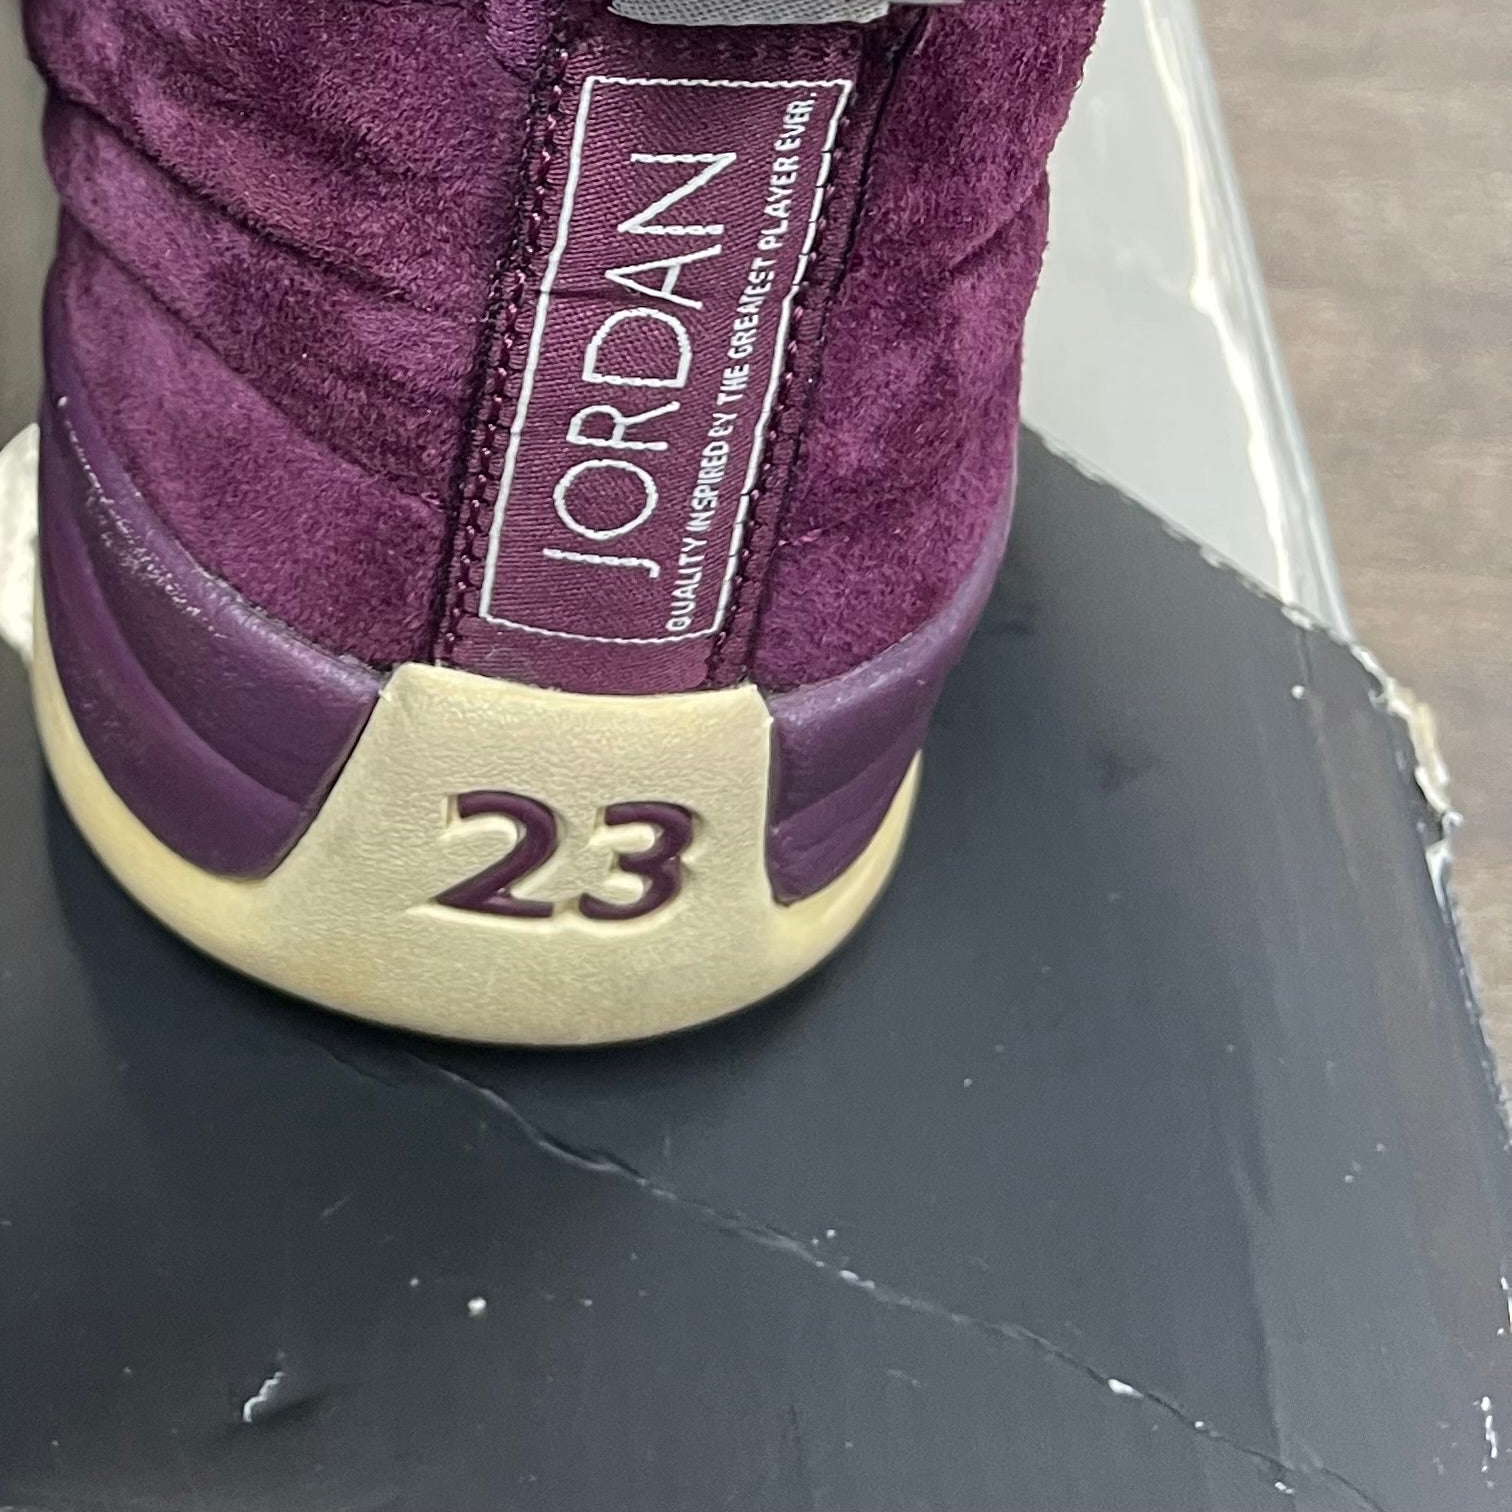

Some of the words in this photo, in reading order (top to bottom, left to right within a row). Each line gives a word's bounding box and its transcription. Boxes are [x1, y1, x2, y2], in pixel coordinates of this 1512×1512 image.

[774, 91, 818, 152] EVER.
[756, 154, 800, 252] PLAYER
[728, 256, 778, 359] GREATEST
[543, 151, 737, 578] JORDAN
[716, 363, 750, 406] THE
[707, 411, 738, 438] BY
[686, 440, 730, 532] INSPIRED
[665, 536, 708, 632] QUALITY
[429, 789, 695, 921] 23
